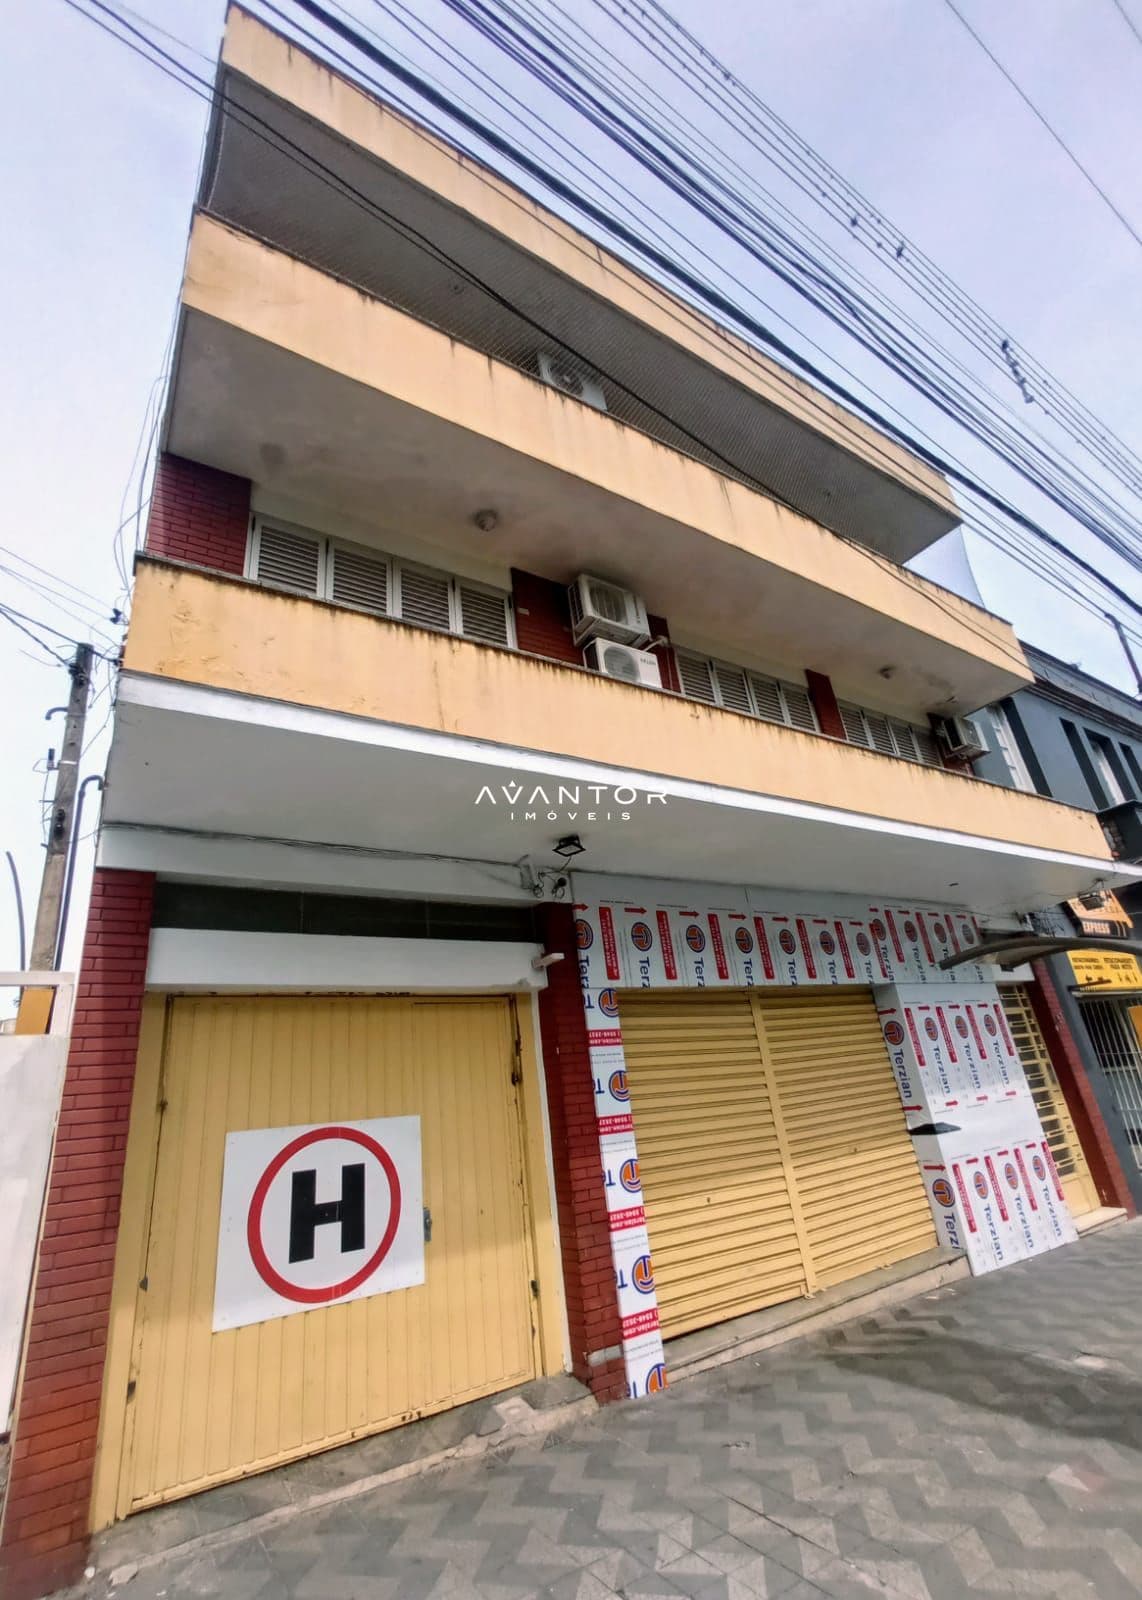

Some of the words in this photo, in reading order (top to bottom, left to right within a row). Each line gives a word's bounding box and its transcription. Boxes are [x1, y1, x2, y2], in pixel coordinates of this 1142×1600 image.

[893, 1048, 913, 1099] Terzian
[931, 1045, 951, 1094] Terzian
[963, 1042, 981, 1089] Terzian
[992, 1039, 1010, 1085] Terzian
[288, 1162, 366, 1264] H
[983, 1203, 1004, 1261] Terzian
[1014, 1194, 1034, 1248] Terzian
[1042, 1185, 1062, 1237] Terzian
